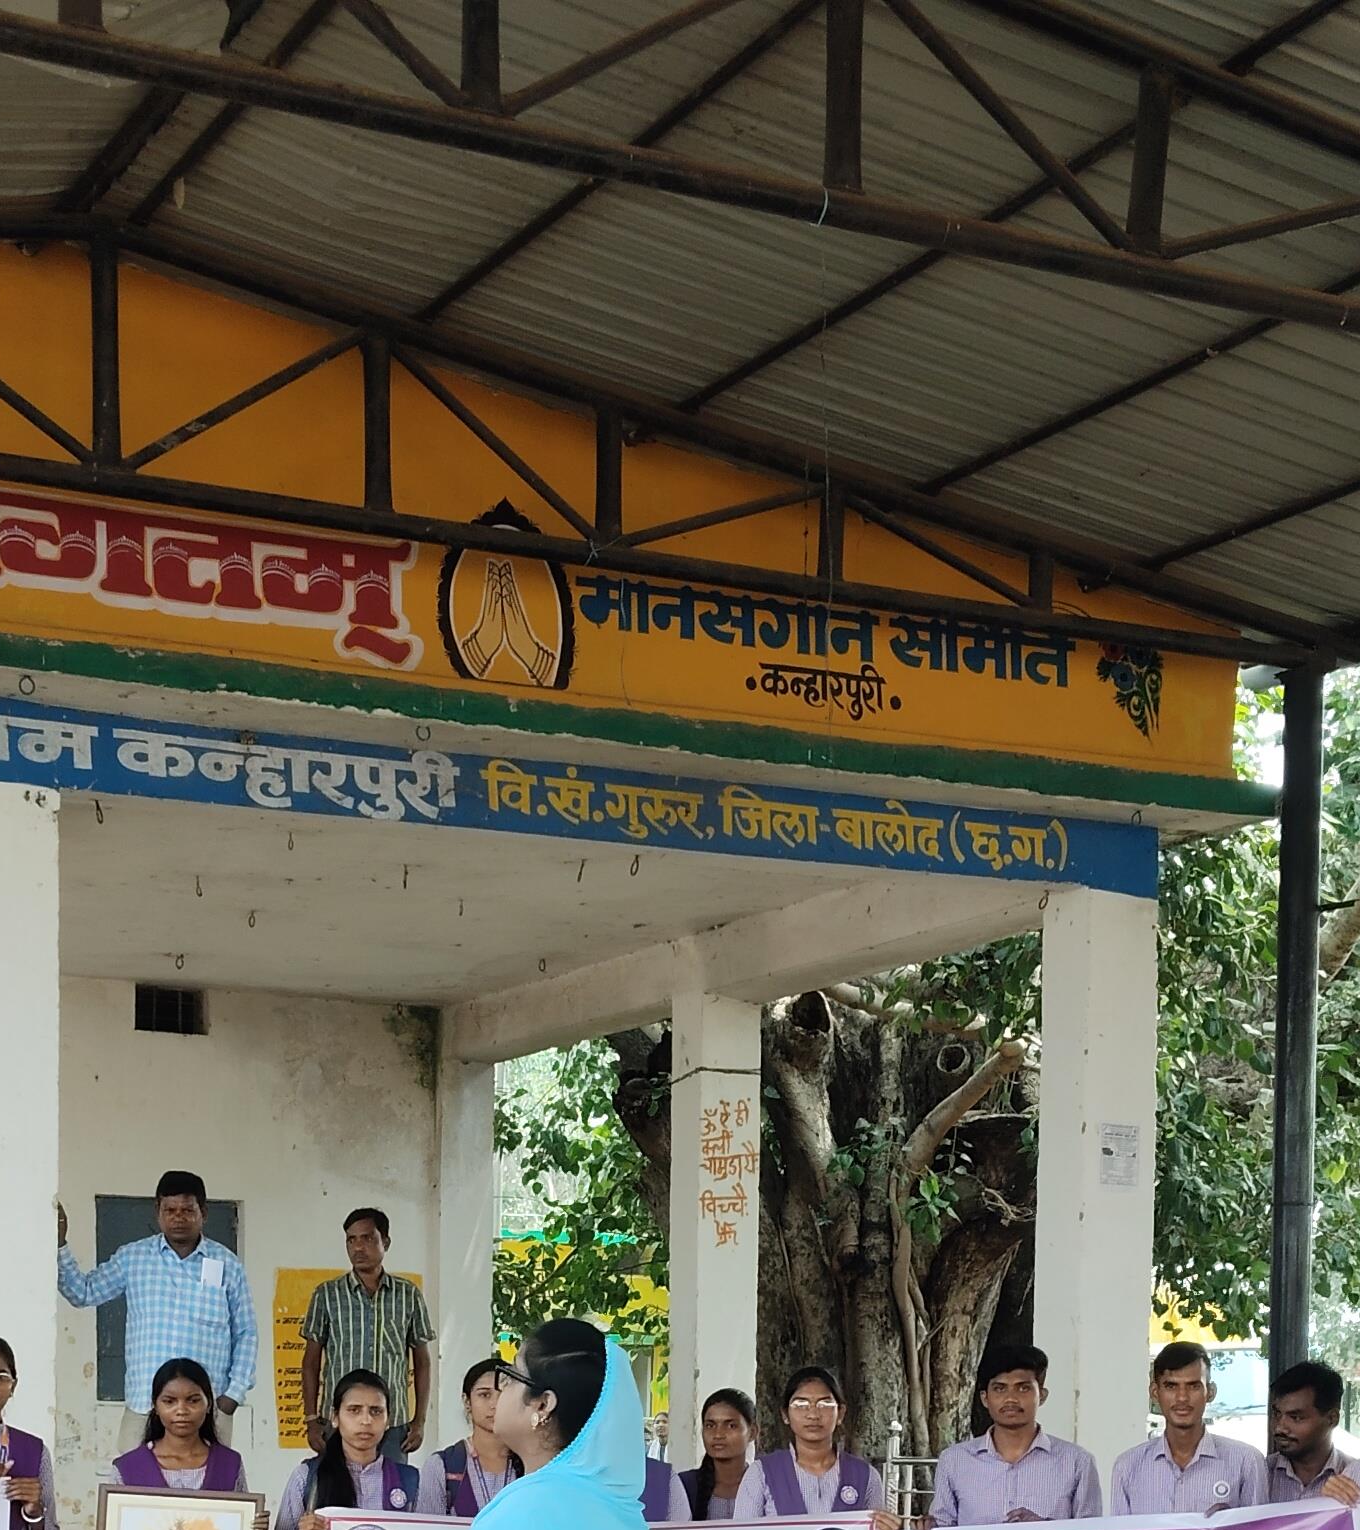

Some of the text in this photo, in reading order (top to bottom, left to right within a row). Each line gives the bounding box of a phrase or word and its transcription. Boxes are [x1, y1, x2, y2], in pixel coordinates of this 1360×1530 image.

[575, 574, 880, 663] मानसगान
[757, 661, 889, 721] कन्हारपुरी
[112, 727, 461, 821] कन्हारपुरी
